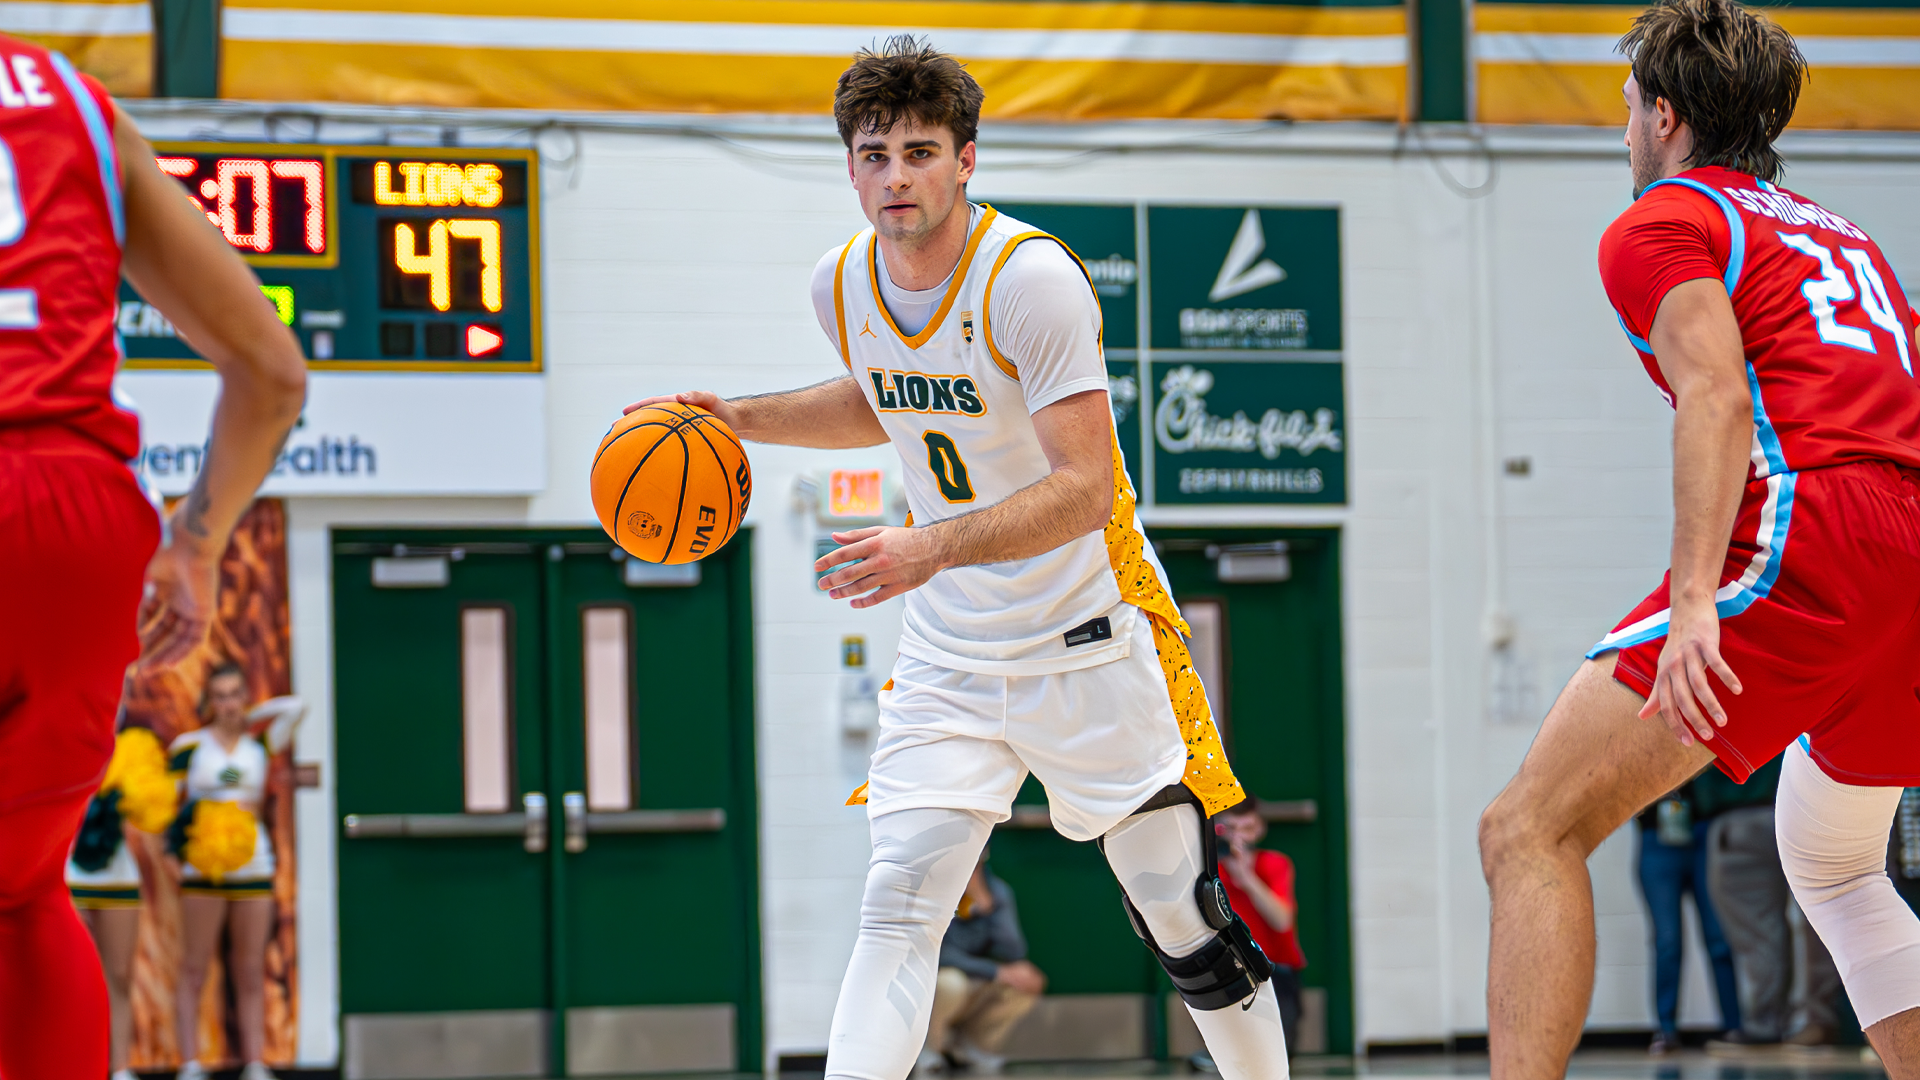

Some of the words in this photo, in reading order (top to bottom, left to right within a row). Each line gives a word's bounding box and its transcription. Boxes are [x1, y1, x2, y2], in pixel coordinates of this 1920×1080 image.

[374, 161, 503, 208] LIONS
[395, 219, 502, 313] 47
[1776, 231, 1913, 378] 24
[867, 367, 987, 418] LIONS
[922, 430, 976, 504] 0
[689, 504, 716, 554] EVO
